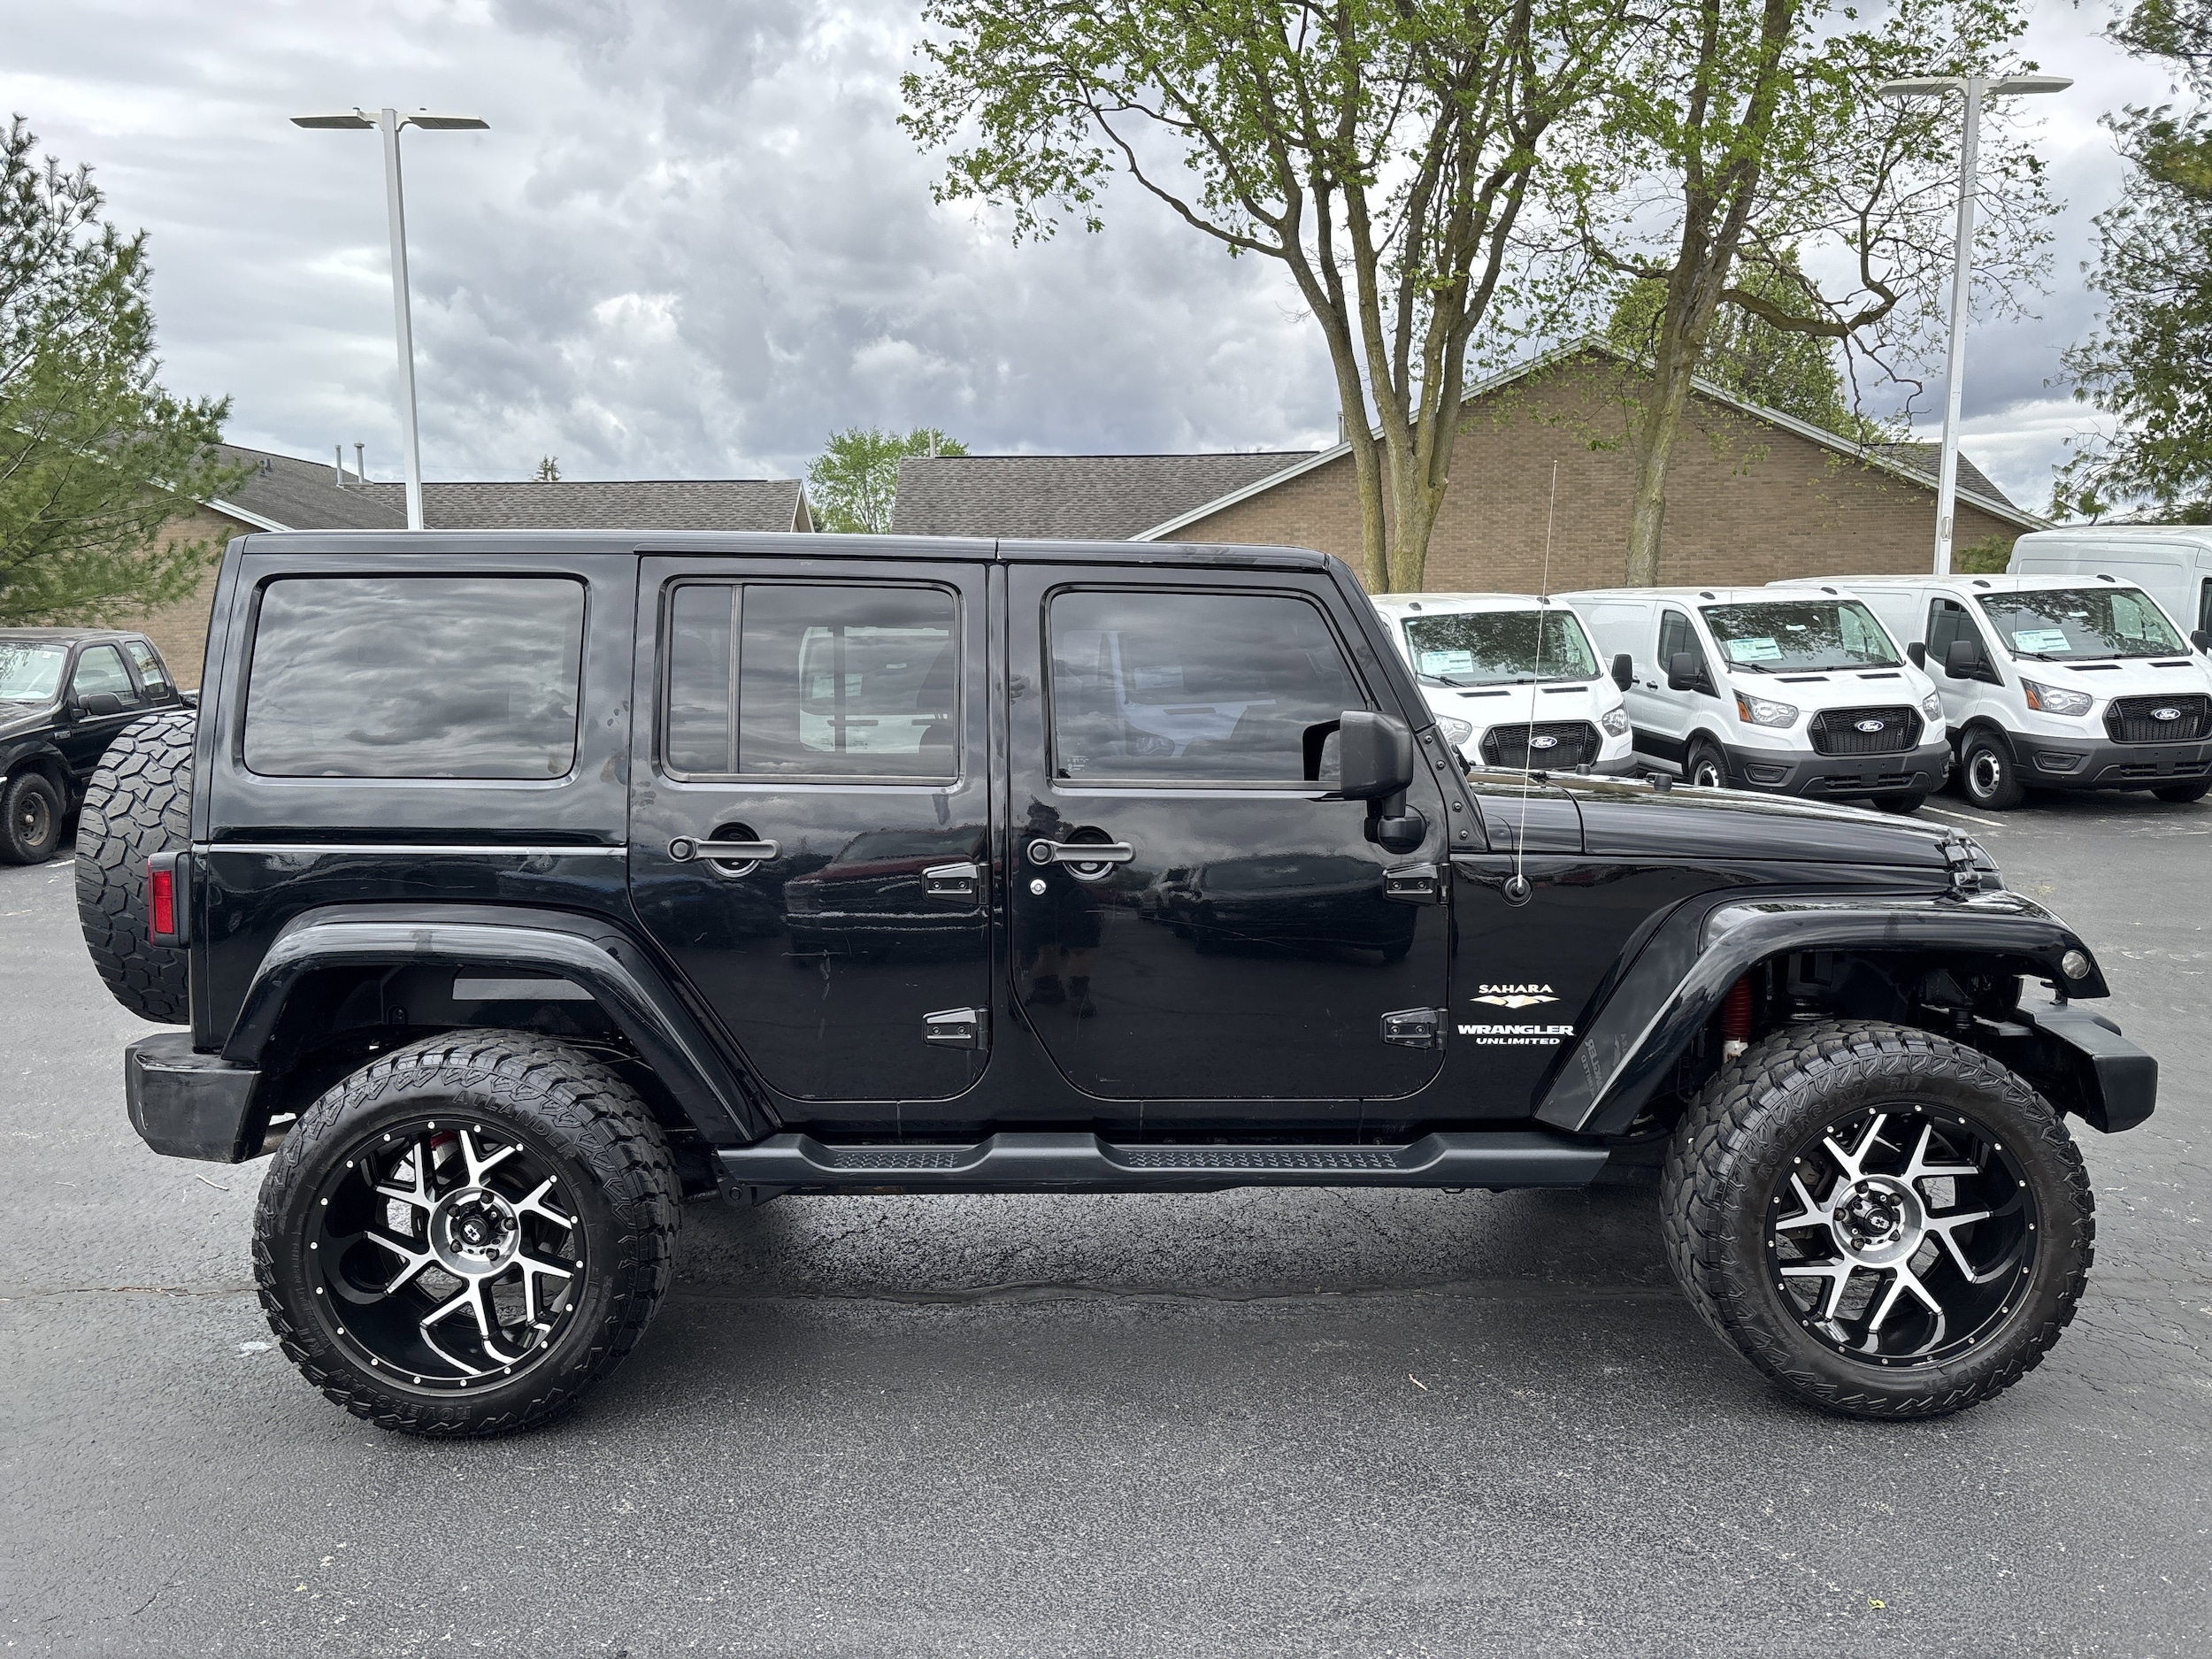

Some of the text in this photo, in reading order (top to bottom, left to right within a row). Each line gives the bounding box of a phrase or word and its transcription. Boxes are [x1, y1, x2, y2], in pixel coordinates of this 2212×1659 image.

[1479, 984, 1555, 994] SAHARA
[1457, 1024, 1577, 1037] WRANGLER
[1476, 1037, 1561, 1046] UNLIMITED
[452, 1090, 577, 1162] ATLANDER
[1757, 1076, 1924, 1181] ROVERCLAW R/T
[329, 1368, 472, 1421] ROVERCLAW
